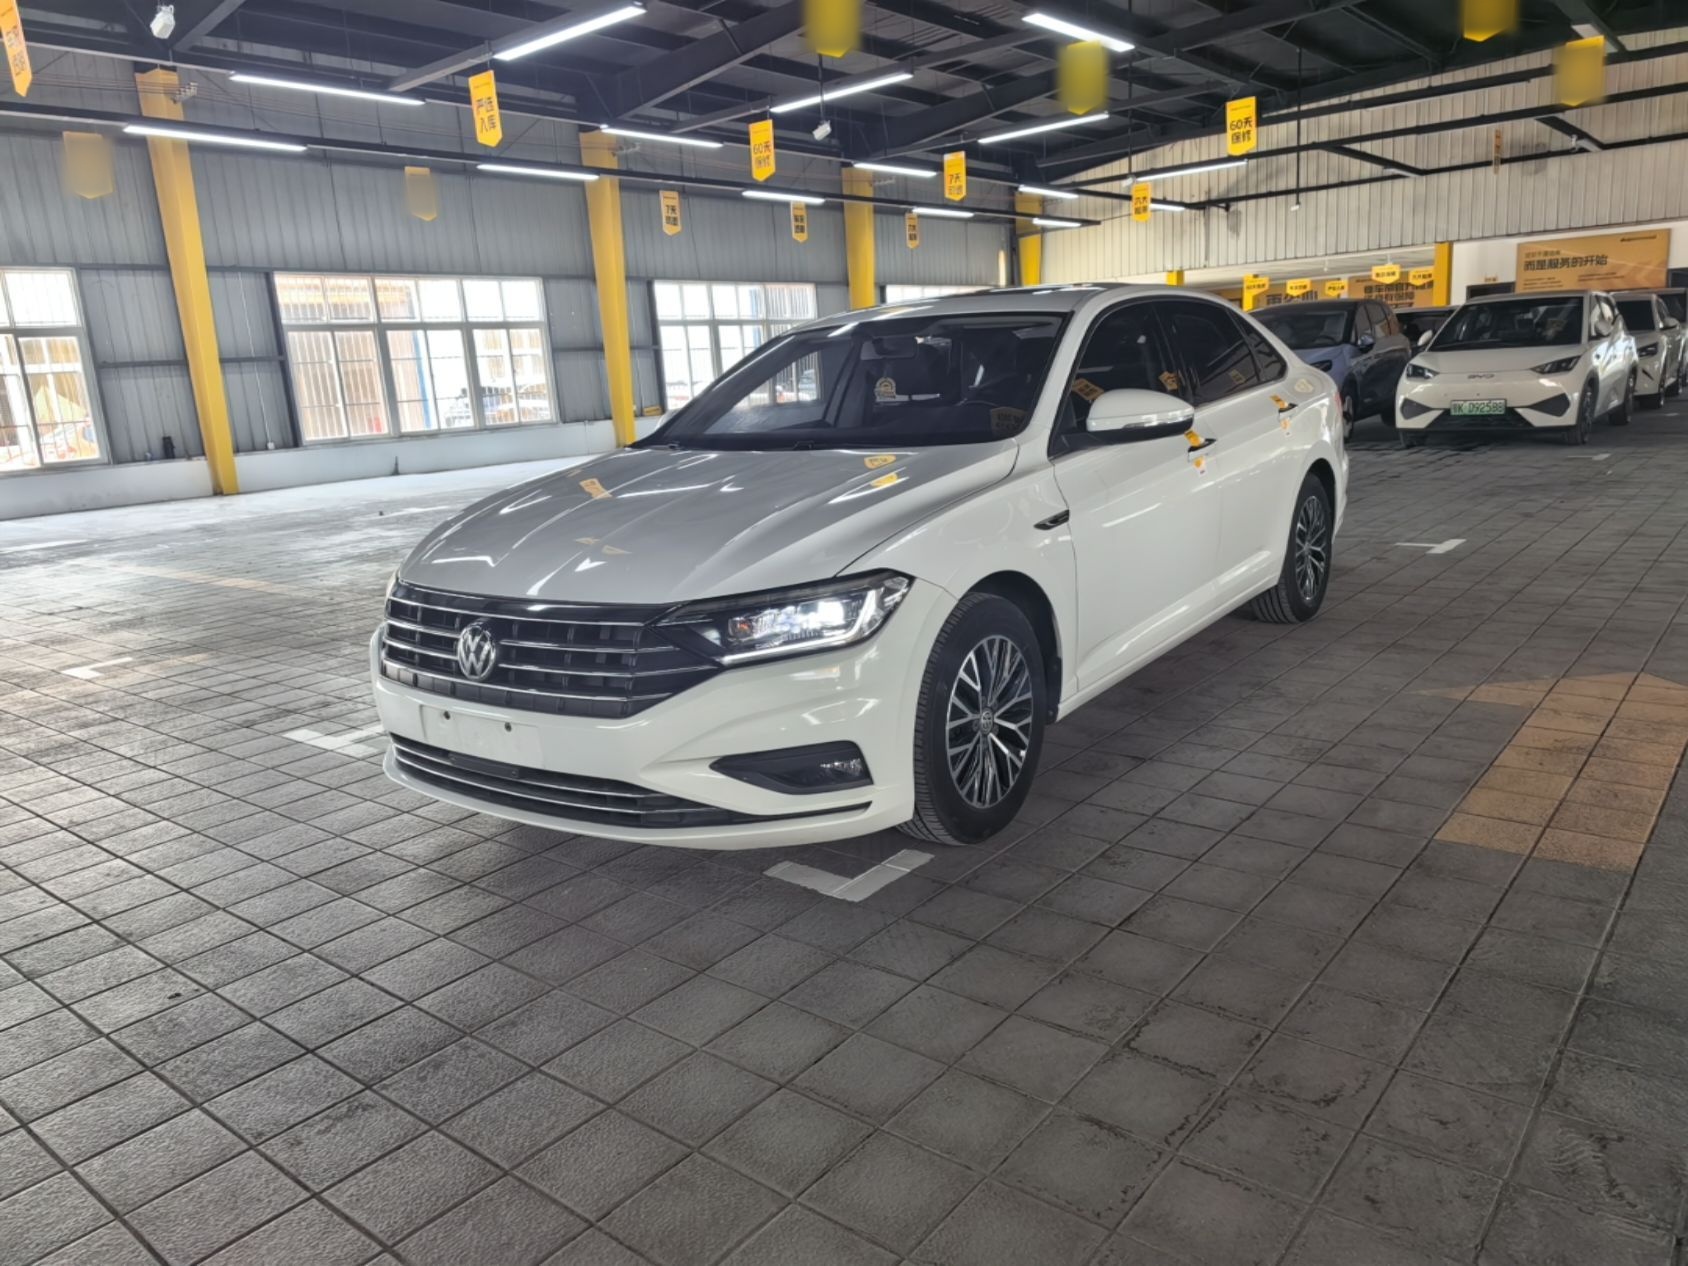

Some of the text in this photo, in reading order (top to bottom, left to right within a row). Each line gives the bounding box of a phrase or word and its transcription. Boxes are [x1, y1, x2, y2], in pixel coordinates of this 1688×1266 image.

[1230, 116, 1253, 131] 60天
[1523, 254, 1608, 272] 而是服务的开始
